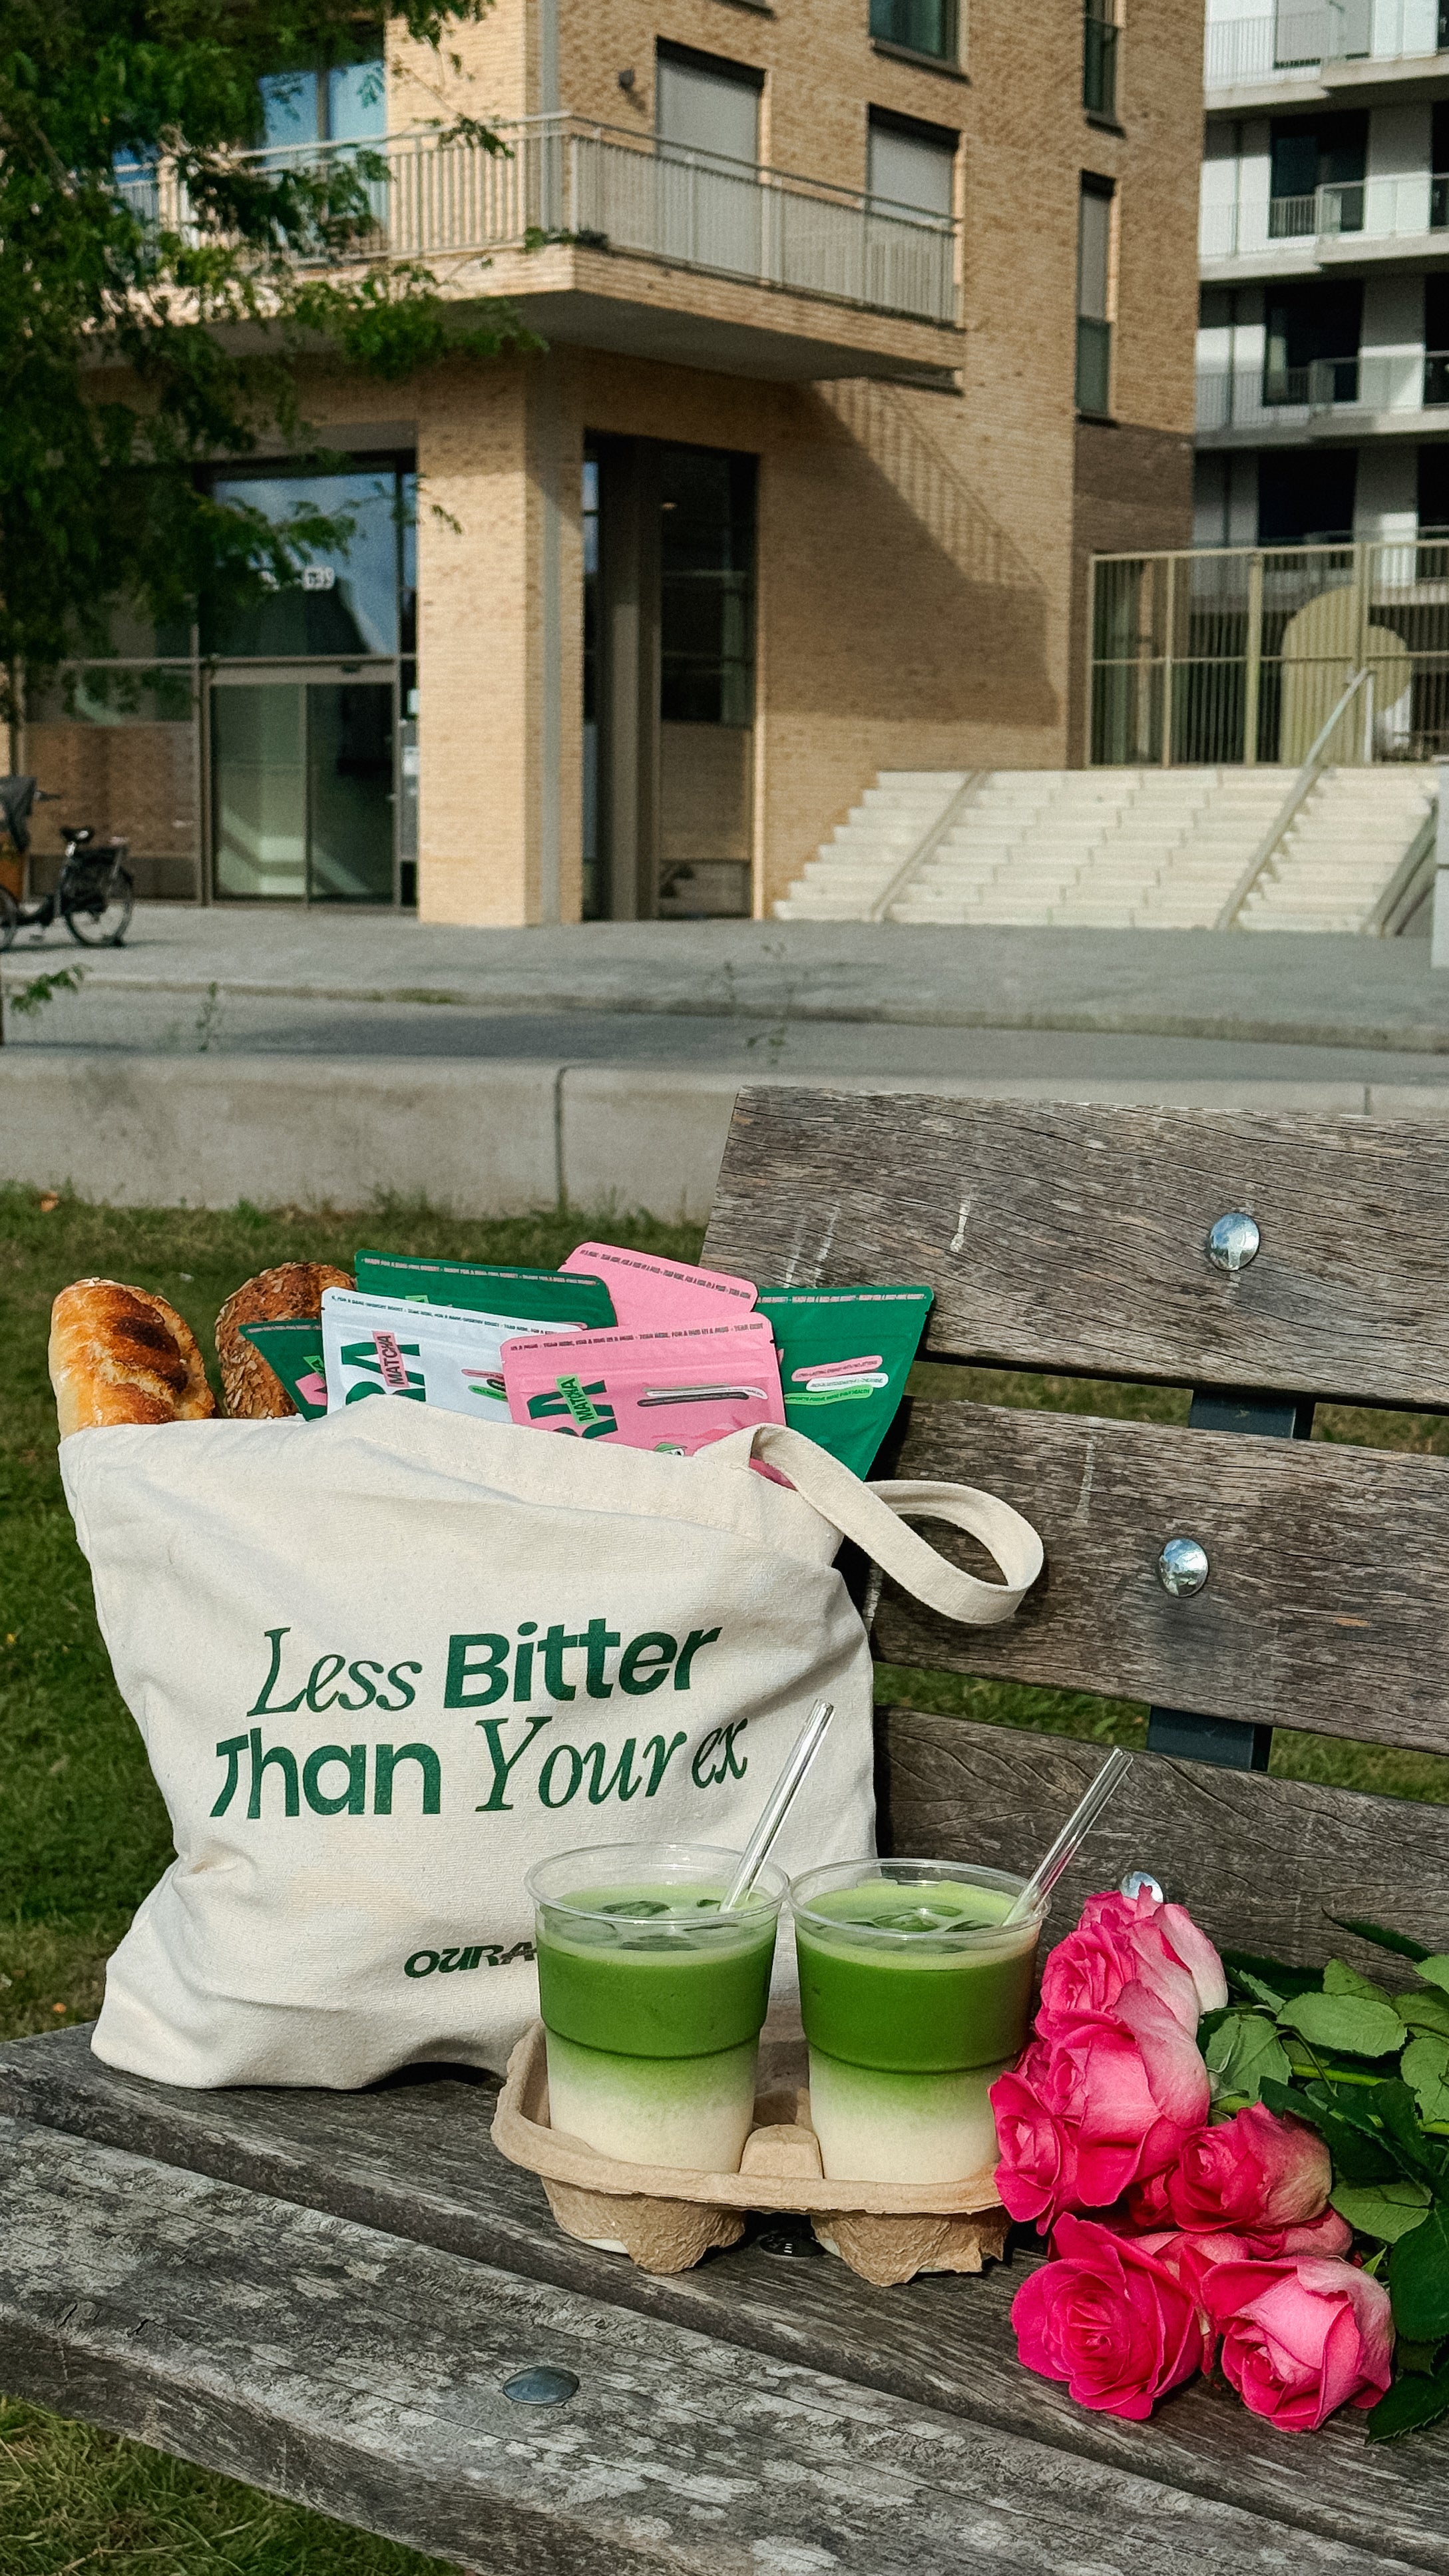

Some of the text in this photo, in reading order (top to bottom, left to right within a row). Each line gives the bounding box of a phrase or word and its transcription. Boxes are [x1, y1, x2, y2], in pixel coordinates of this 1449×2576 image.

[376, 1335, 405, 1385] MATCHA
[246, 1618, 723, 1717] Less Bitter
[210, 1715, 749, 1820] Than Your ex
